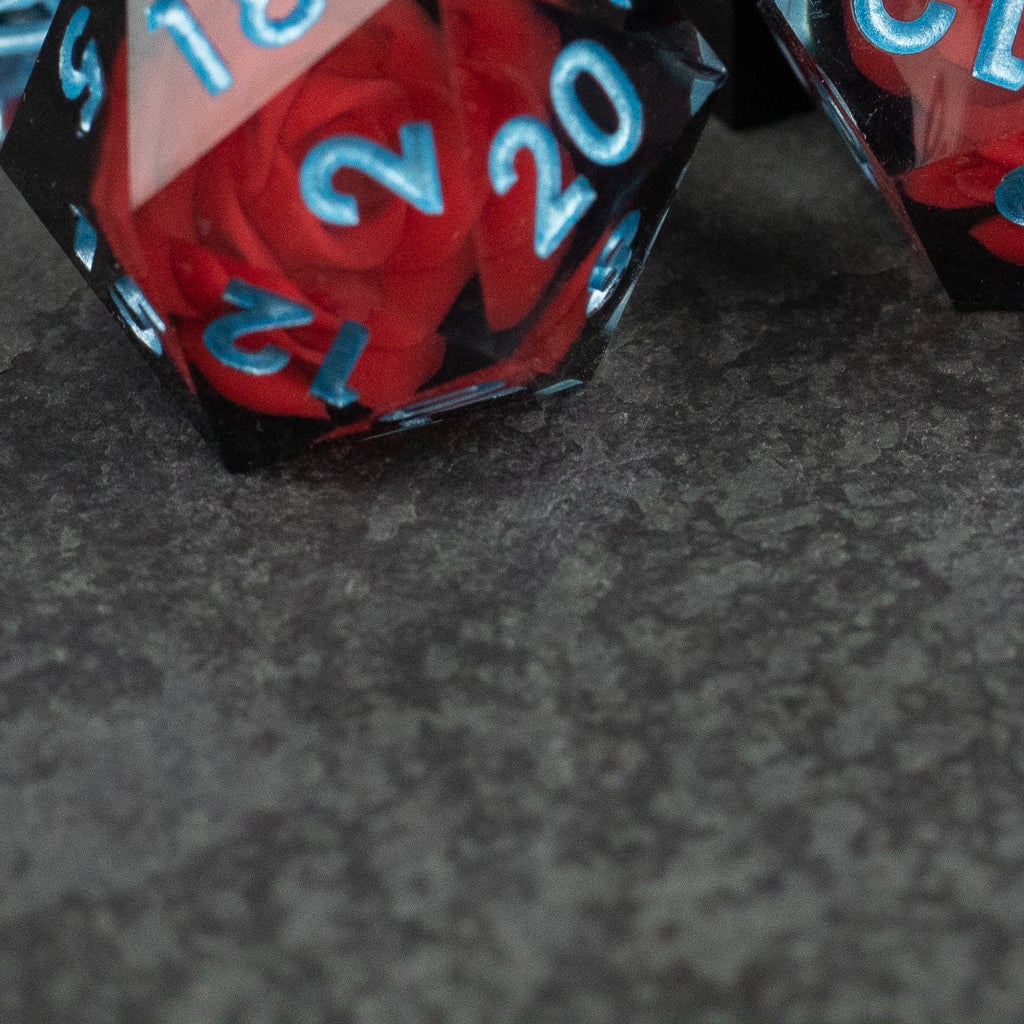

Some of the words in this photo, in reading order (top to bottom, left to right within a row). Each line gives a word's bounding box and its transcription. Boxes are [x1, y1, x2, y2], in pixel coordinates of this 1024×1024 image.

[299, 122, 446, 227] 2
[488, 38, 645, 260] 20
[202, 276, 370, 409] 12
